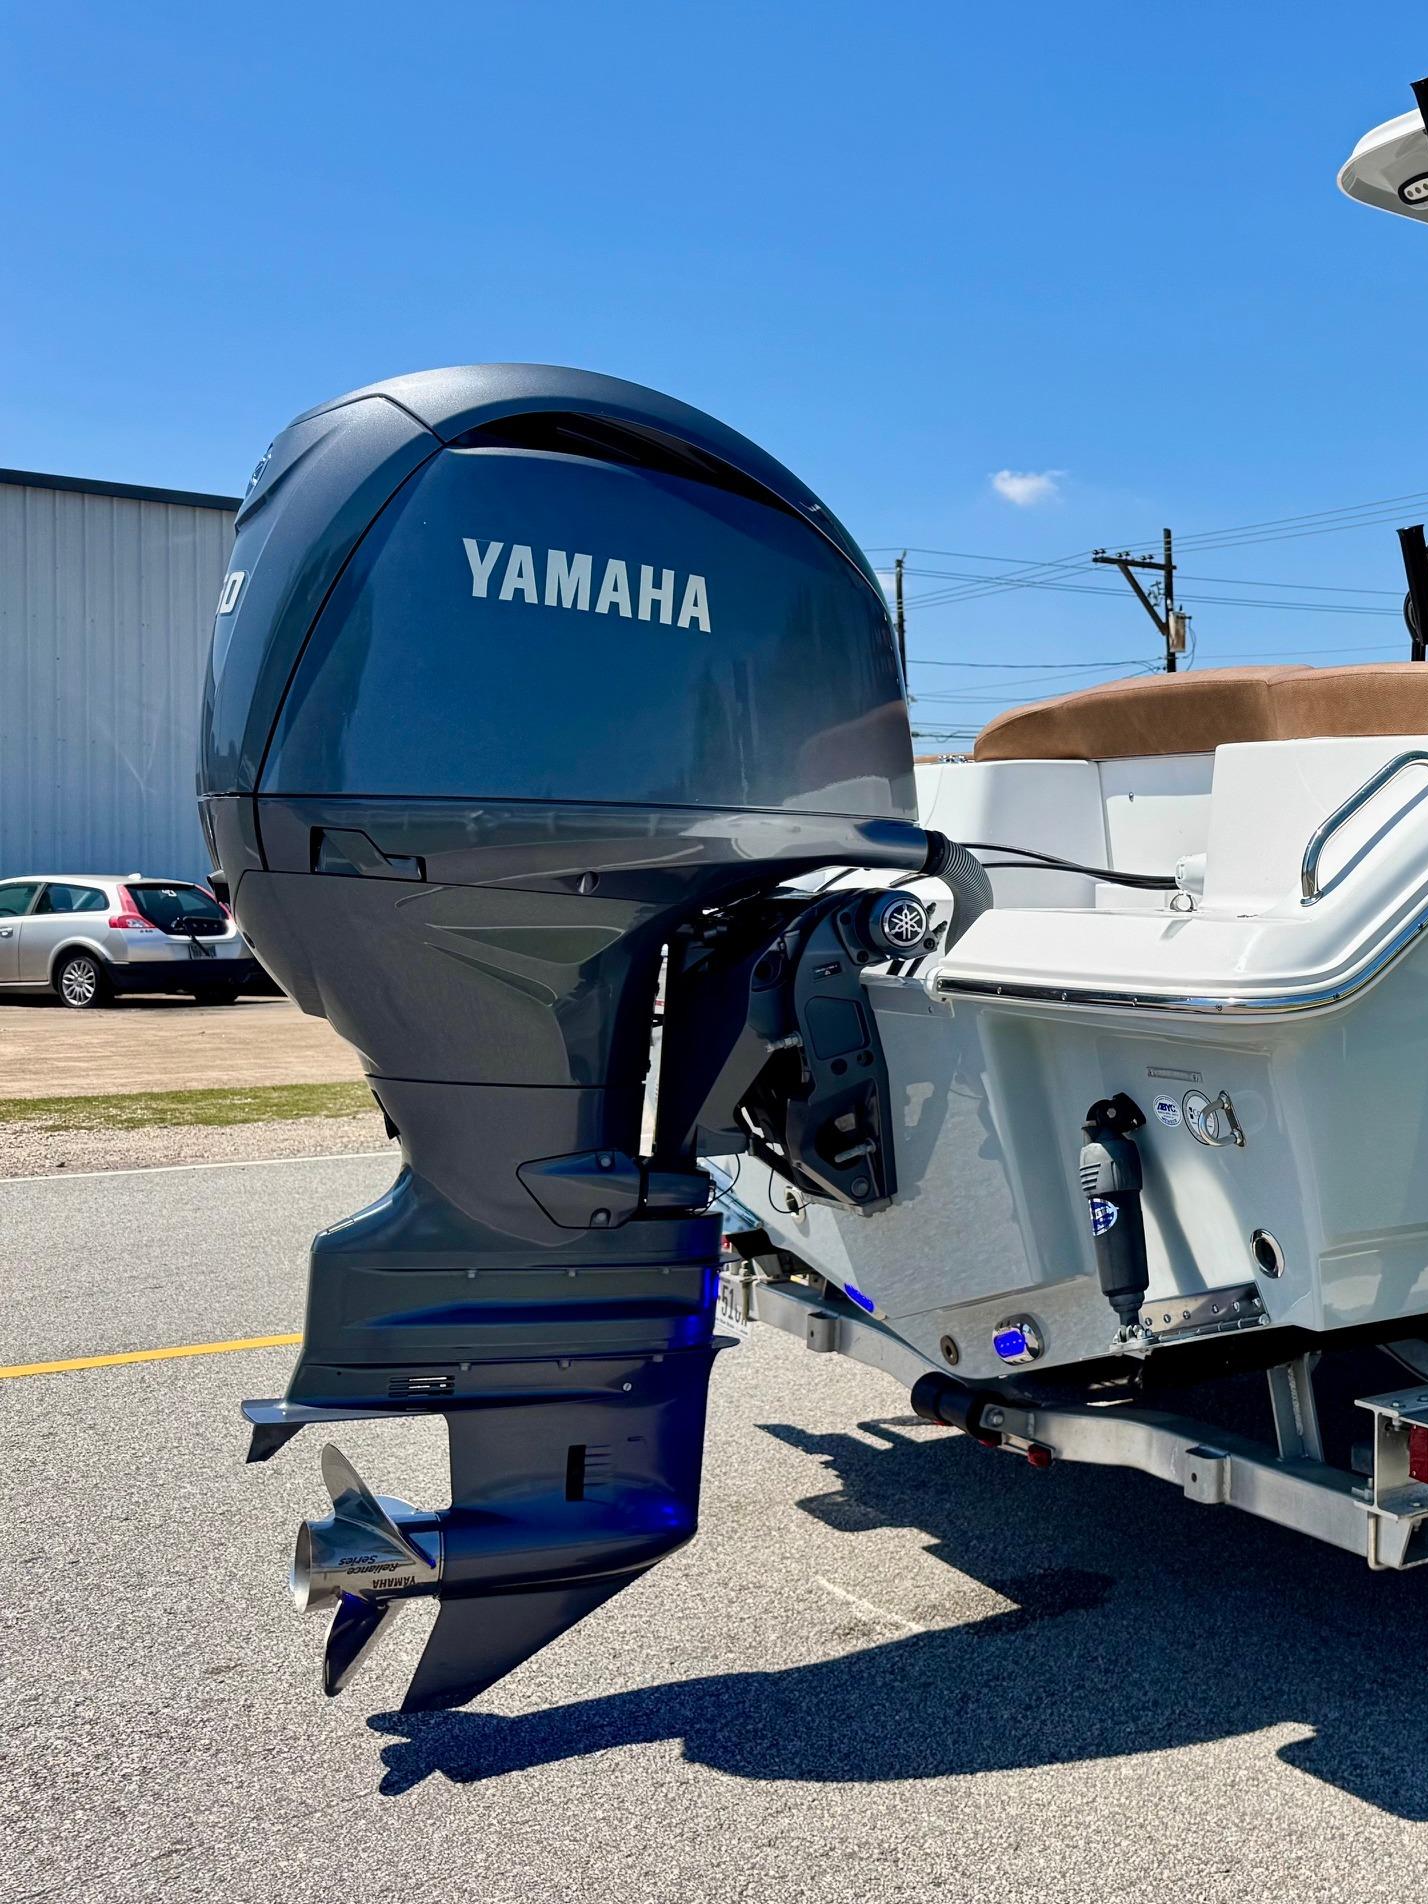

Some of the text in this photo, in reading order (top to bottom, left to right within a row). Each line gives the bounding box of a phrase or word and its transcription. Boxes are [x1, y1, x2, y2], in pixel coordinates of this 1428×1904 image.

[462, 537, 712, 634] YAMAHA
[337, 1554, 378, 1567] Series
[346, 1562, 399, 1576] Reliance
[372, 1576, 416, 1589] YAMAHA
